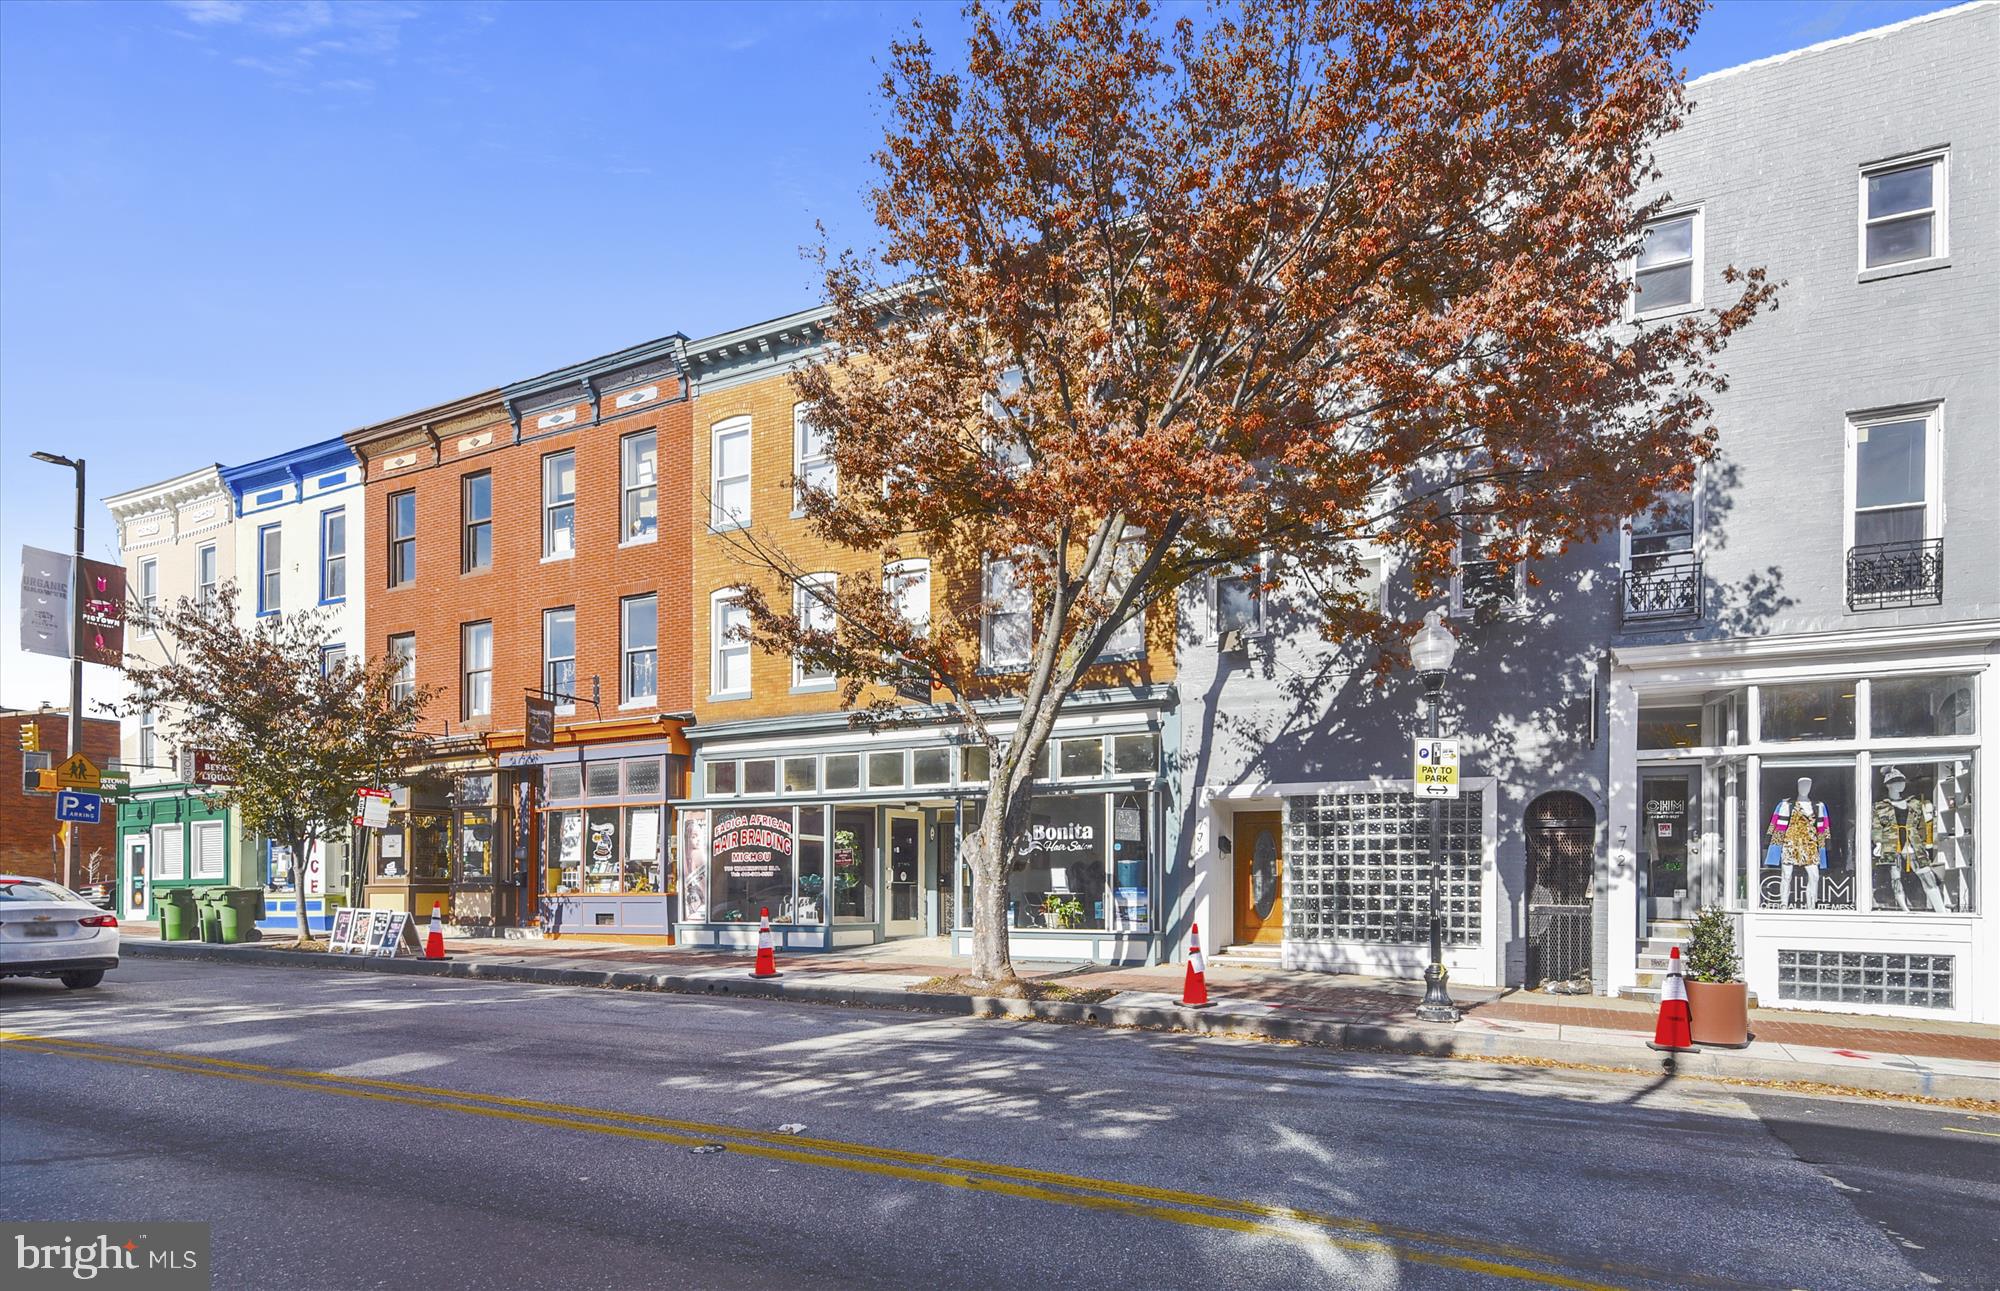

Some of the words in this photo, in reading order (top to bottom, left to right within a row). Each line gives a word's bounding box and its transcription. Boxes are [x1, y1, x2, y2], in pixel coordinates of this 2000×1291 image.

[83, 613, 120, 627] PIGTOWN
[1421, 766, 1438, 774] PAY
[1440, 766, 1453, 774] TO
[1425, 774, 1449, 783] PARK
[714, 815, 748, 838] FADIGA
[749, 814, 792, 835] AFRICAN
[1032, 822, 1094, 840] Bonita
[713, 831, 739, 857] HAIR
[740, 828, 792, 856] BRAIDING
[1044, 840, 1066, 852] Hair
[1067, 840, 1093, 852] Salon
[731, 851, 772, 863] MICHOU
[1831, 903, 1856, 911] MESS
